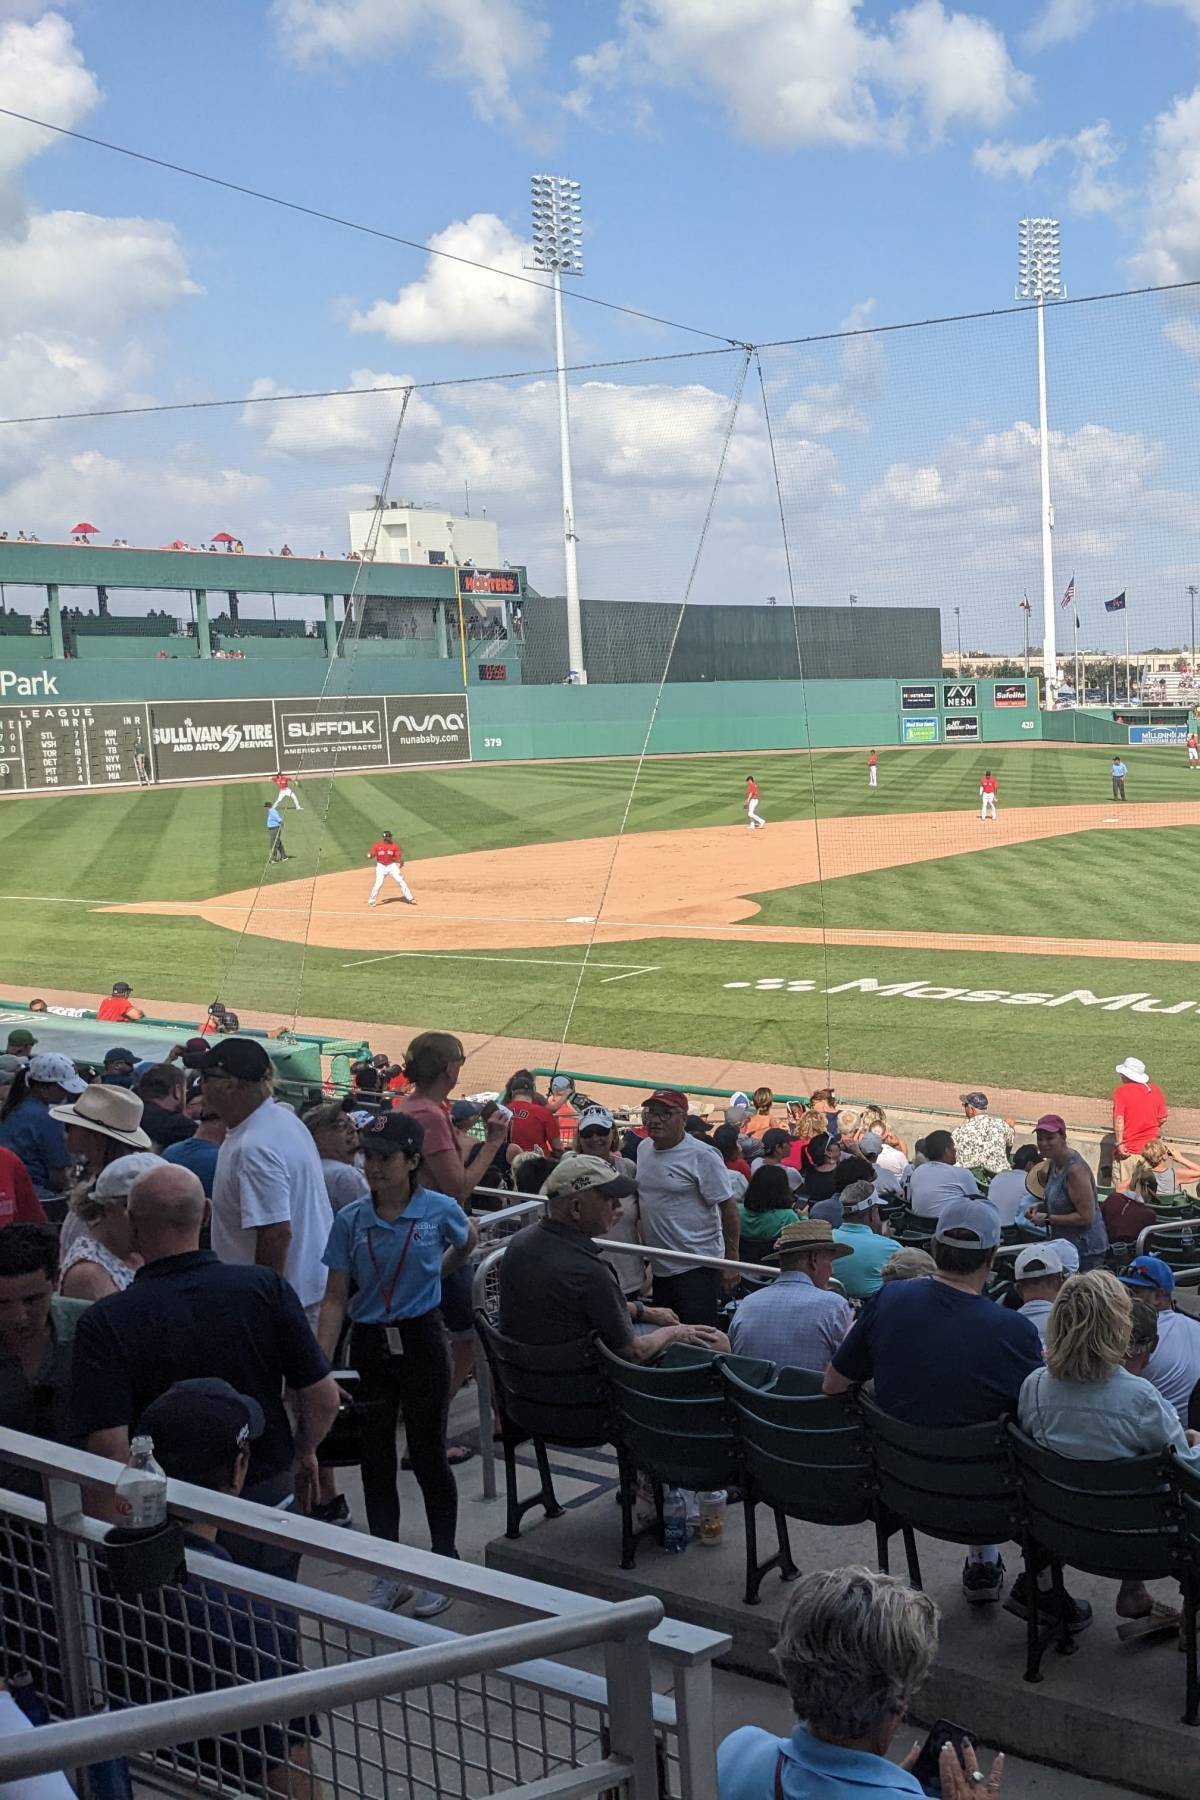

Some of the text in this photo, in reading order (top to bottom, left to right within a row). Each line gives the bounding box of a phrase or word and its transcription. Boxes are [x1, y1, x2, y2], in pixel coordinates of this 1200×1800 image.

[464, 576, 514, 592] HOOTERS
[0, 670, 59, 696] Park
[948, 698, 972, 706] NESN
[20, 708, 93, 718] LEAGUE
[26, 720, 32, 728] P
[60, 718, 69, 727] IN
[73, 718, 79, 726] R
[89, 718, 94, 726] P
[135, 716, 140, 724] R
[392, 714, 464, 732] nuna
[153, 724, 272, 744] SULLIVAN TIRE
[288, 720, 376, 738] SUFFOLK
[400, 734, 458, 745] nunababy.com
[484, 738, 502, 747] 379
[173, 740, 274, 752] AND AUTO SERVICE
[284, 744, 382, 755] AMERICA'S CONTRACTOR
[46, 768, 57, 776] PIT
